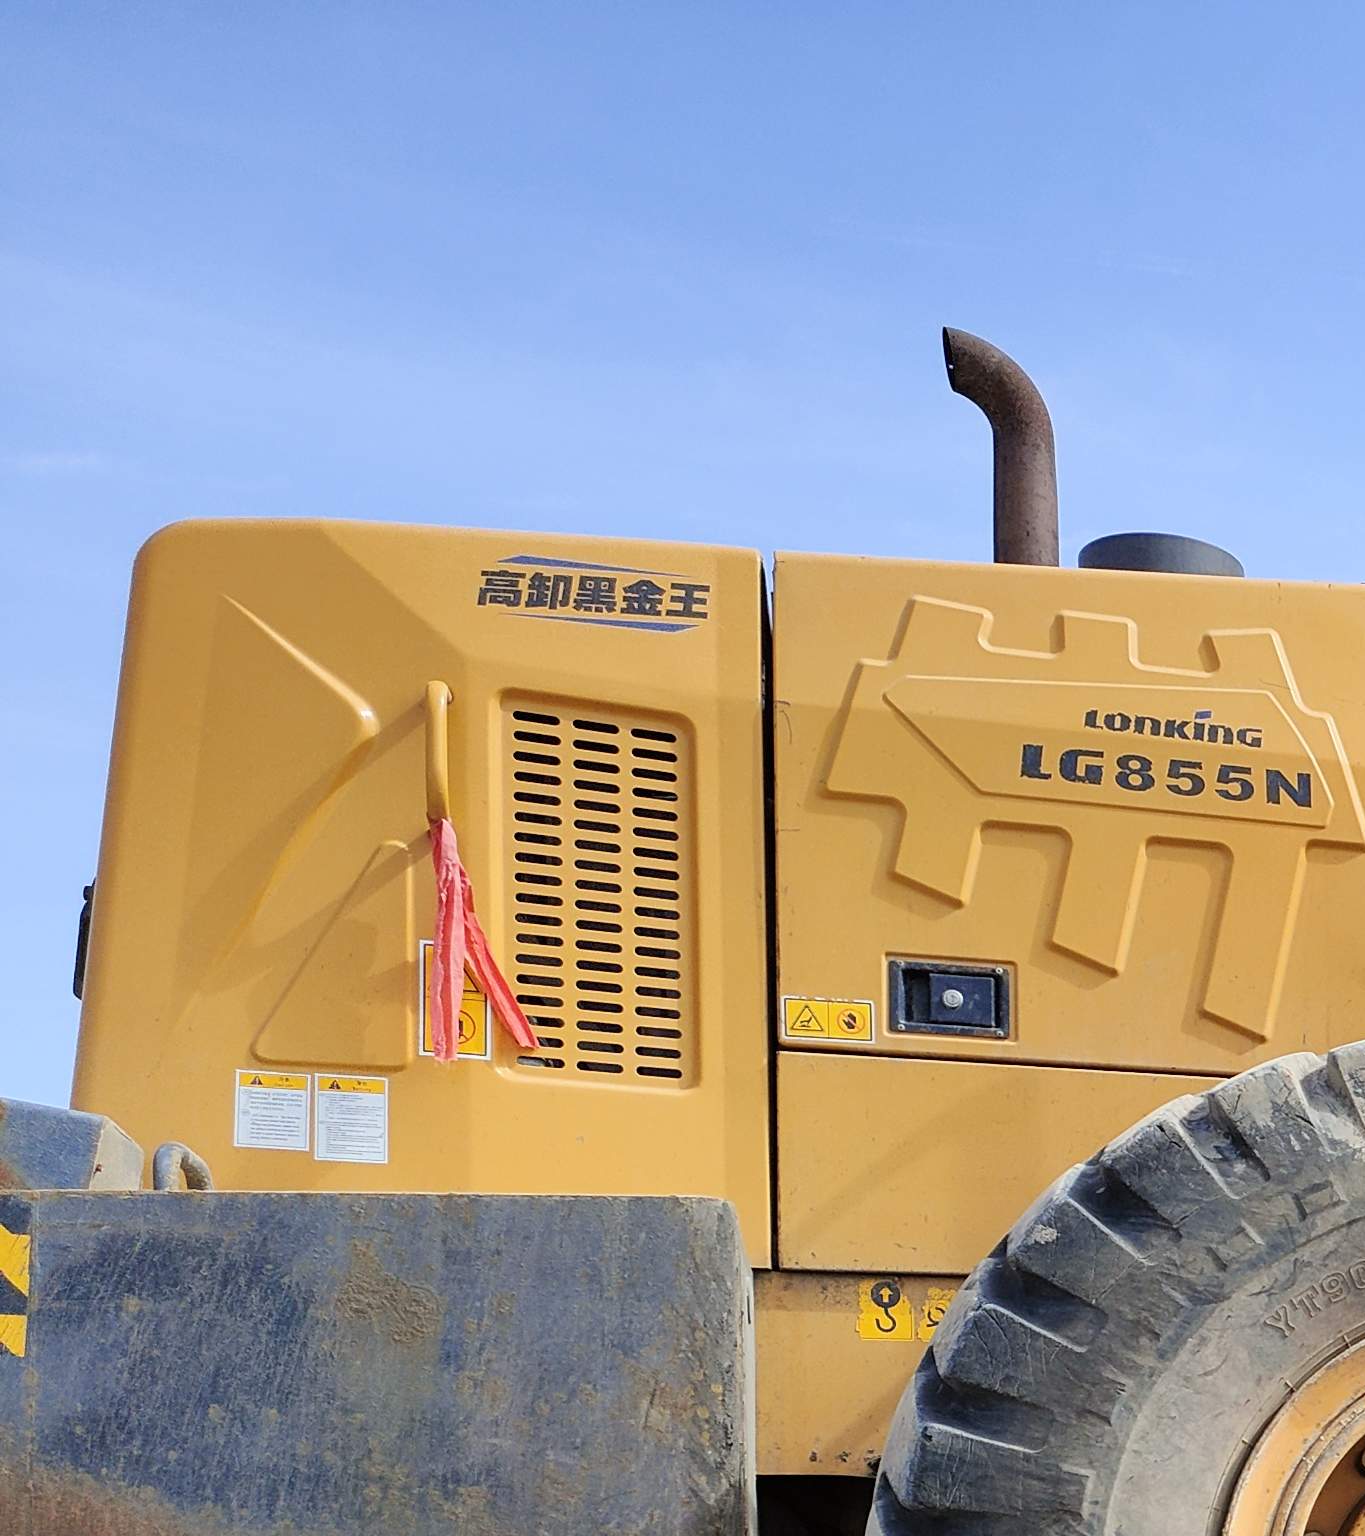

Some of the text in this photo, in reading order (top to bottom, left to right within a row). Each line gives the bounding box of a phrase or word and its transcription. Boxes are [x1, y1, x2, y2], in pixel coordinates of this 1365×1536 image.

[478, 568, 709, 620] 高卸黑金王
[1020, 743, 1314, 808] LG855N
